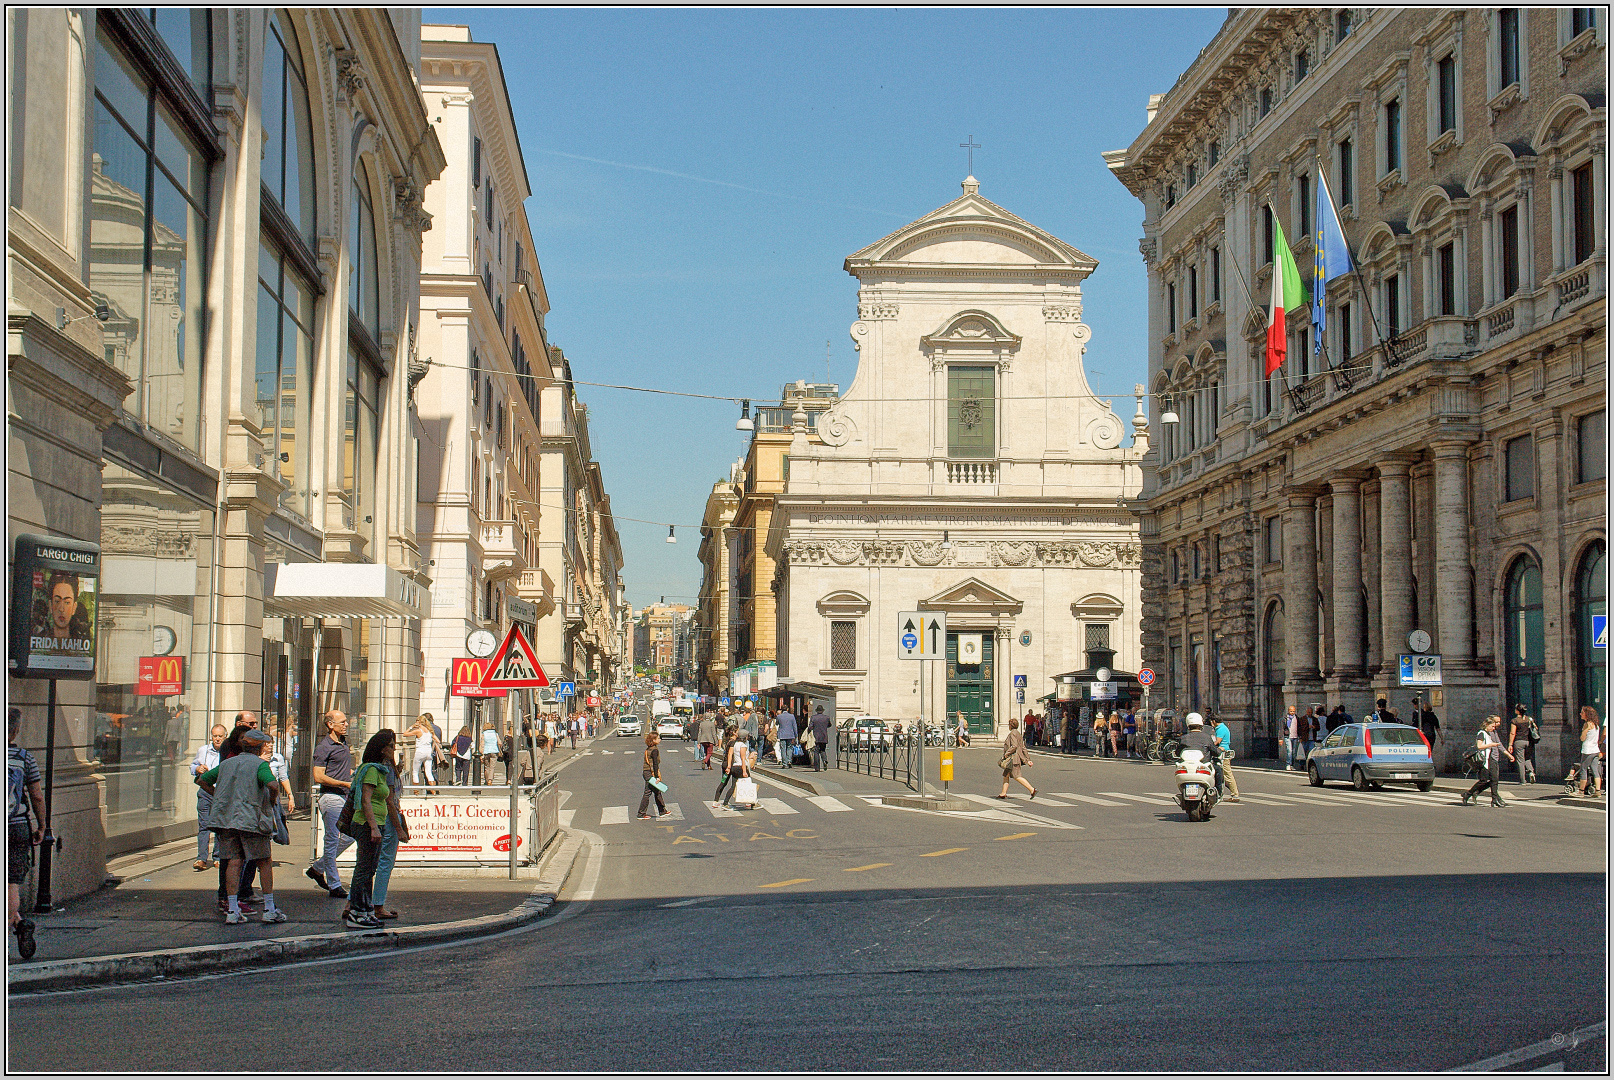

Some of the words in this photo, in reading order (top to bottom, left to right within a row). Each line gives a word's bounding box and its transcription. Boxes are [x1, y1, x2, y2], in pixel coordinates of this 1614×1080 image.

[809, 514, 834, 525] DEO
[836, 514, 848, 525] IN
[851, 514, 878, 525] HON
[880, 514, 931, 525] MARIAE
[935, 515, 991, 526] VIRGINIS
[992, 516, 1039, 526] MATRIS
[1041, 516, 1059, 526] DEI
[36, 547, 68, 561] LARGO
[69, 551, 94, 564] CHIGI
[30, 636, 59, 650] FRIDA
[61, 637, 91, 651] KAHLO
[399, 804, 430, 818] reria
[434, 804, 462, 818] M.T.
[465, 804, 522, 819] Cicerone
[414, 823, 429, 831] del
[431, 823, 455, 831] Libro
[457, 823, 506, 831] Economico
[426, 832, 435, 840] &
[436, 832, 477, 842] Compton
[672, 828, 820, 845] ATAC
